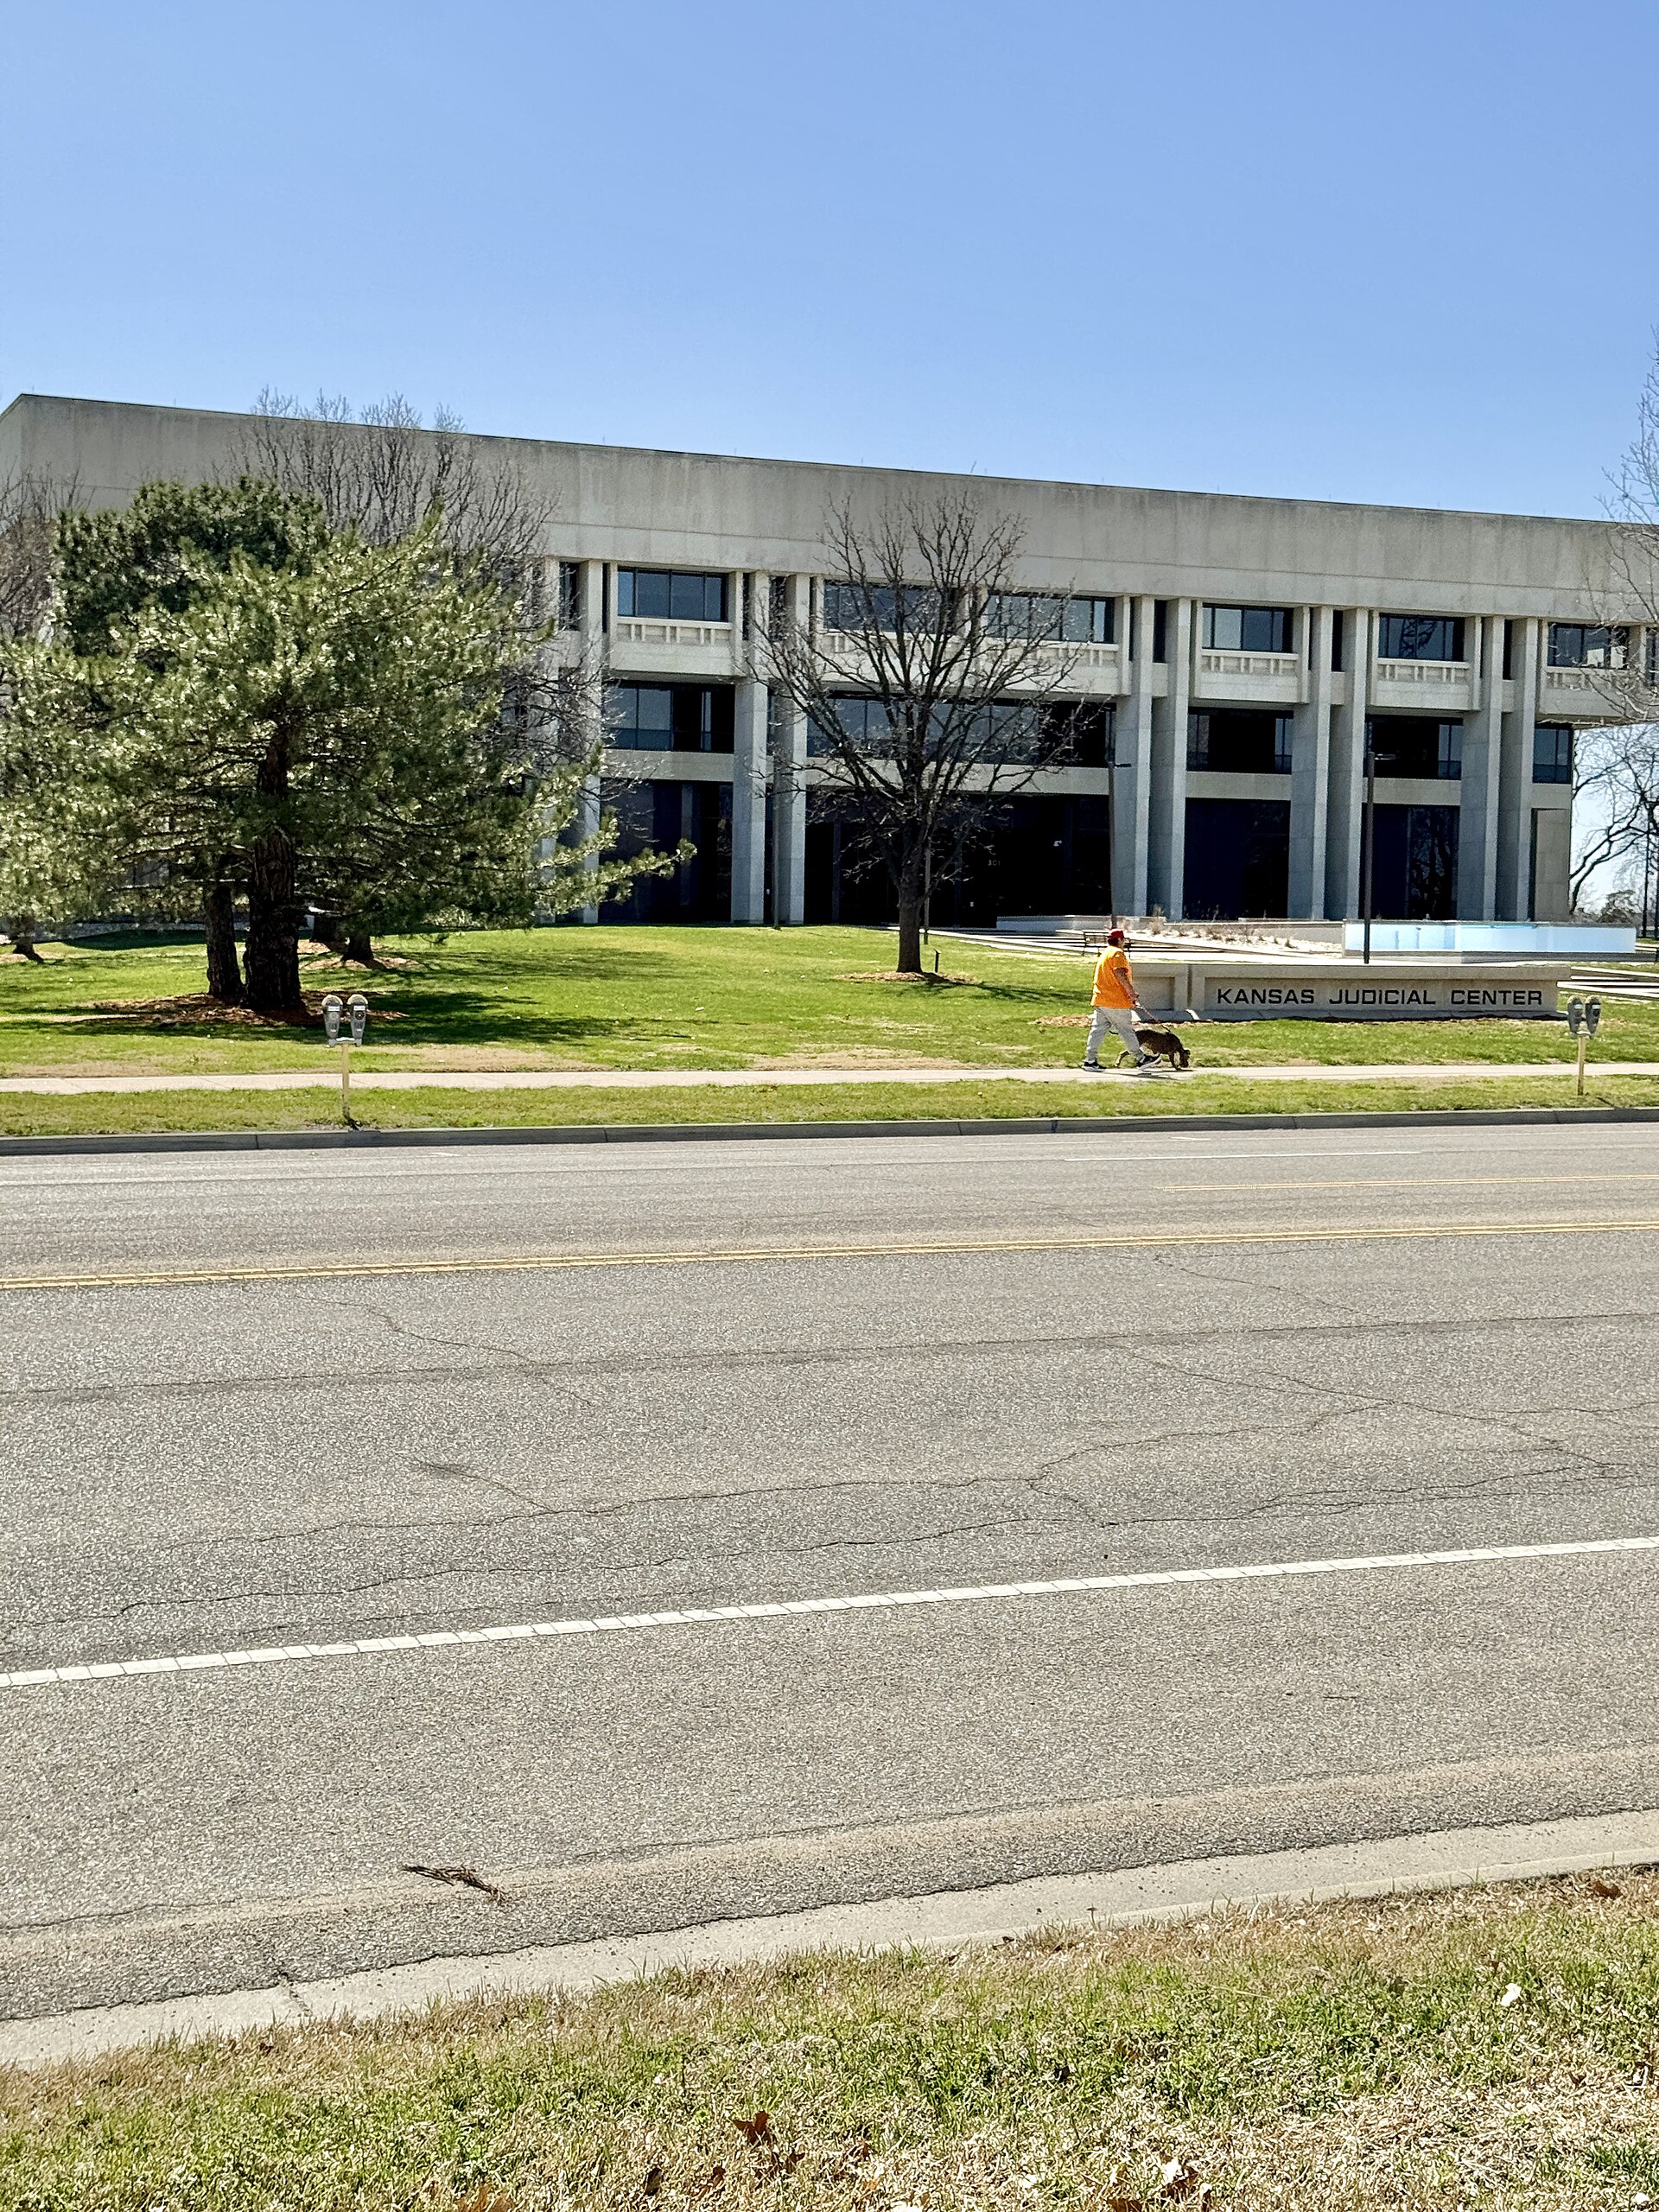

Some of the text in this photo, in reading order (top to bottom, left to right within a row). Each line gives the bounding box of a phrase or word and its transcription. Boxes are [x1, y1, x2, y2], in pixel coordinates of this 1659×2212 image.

[1217, 988, 1542, 1005] KANSAS JUDICIAL CENTER
